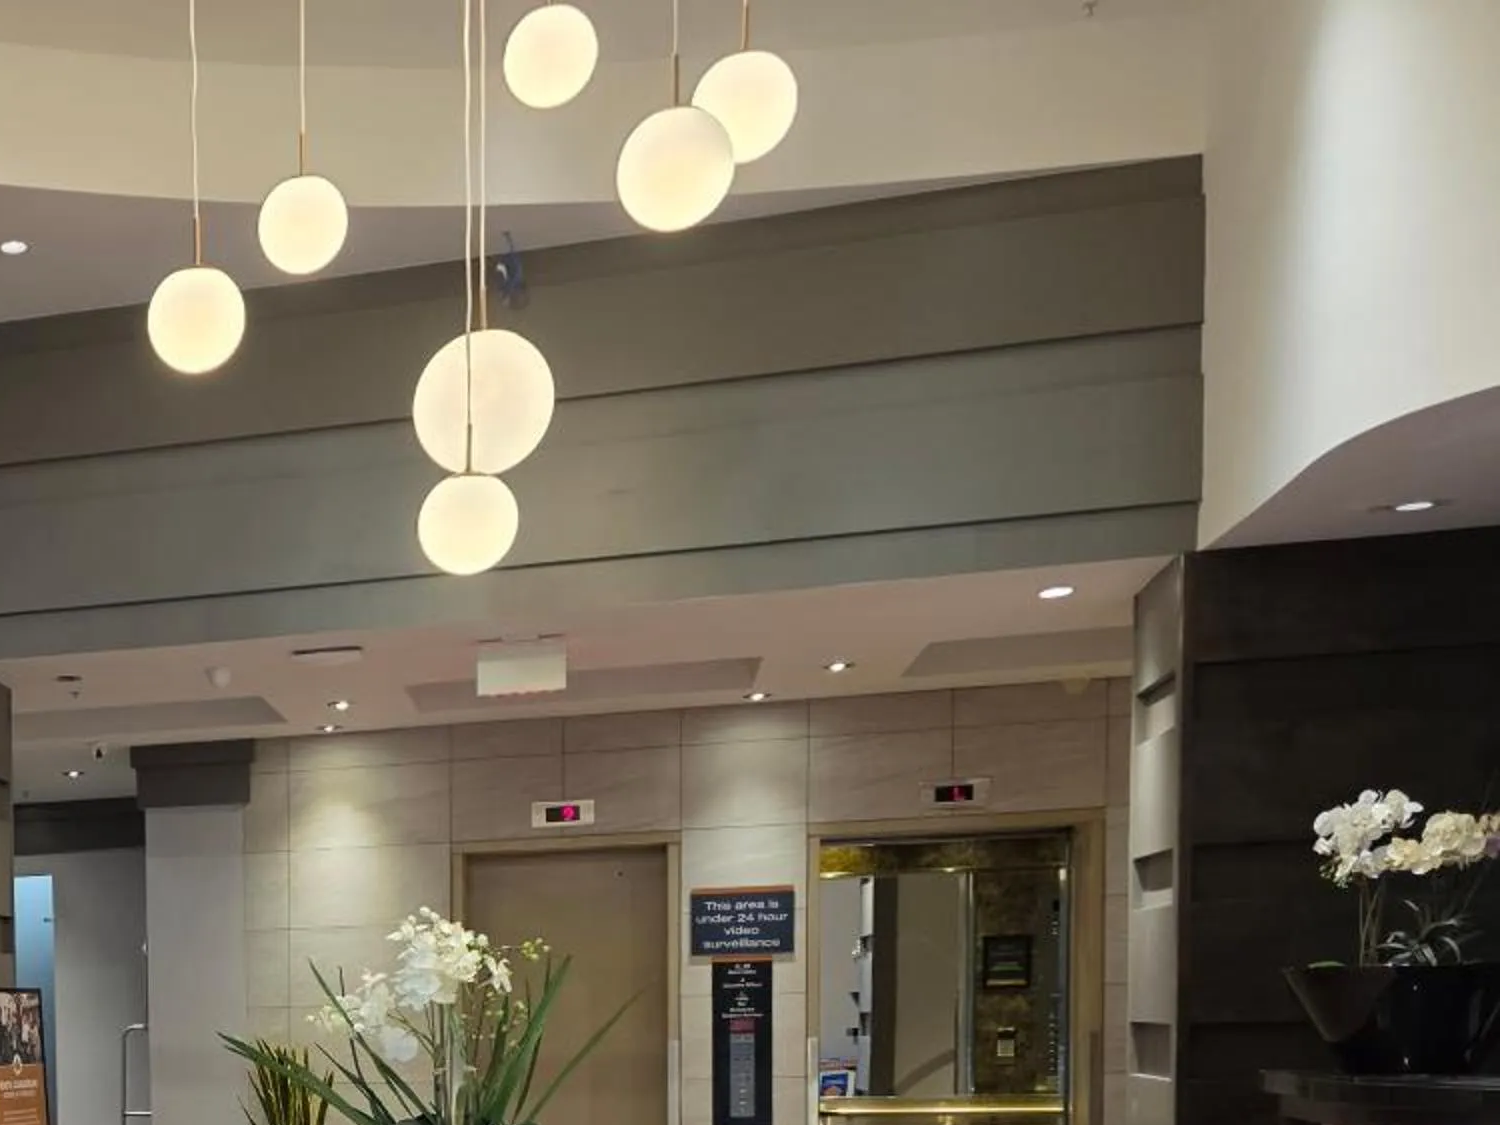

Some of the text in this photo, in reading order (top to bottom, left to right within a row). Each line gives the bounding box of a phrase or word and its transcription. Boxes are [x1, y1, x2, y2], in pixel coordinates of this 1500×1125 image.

[703, 900, 779, 911] This area is
[695, 913, 788, 924] under 24 hour
[724, 926, 760, 936] video
[703, 938, 781, 949] surveillance
